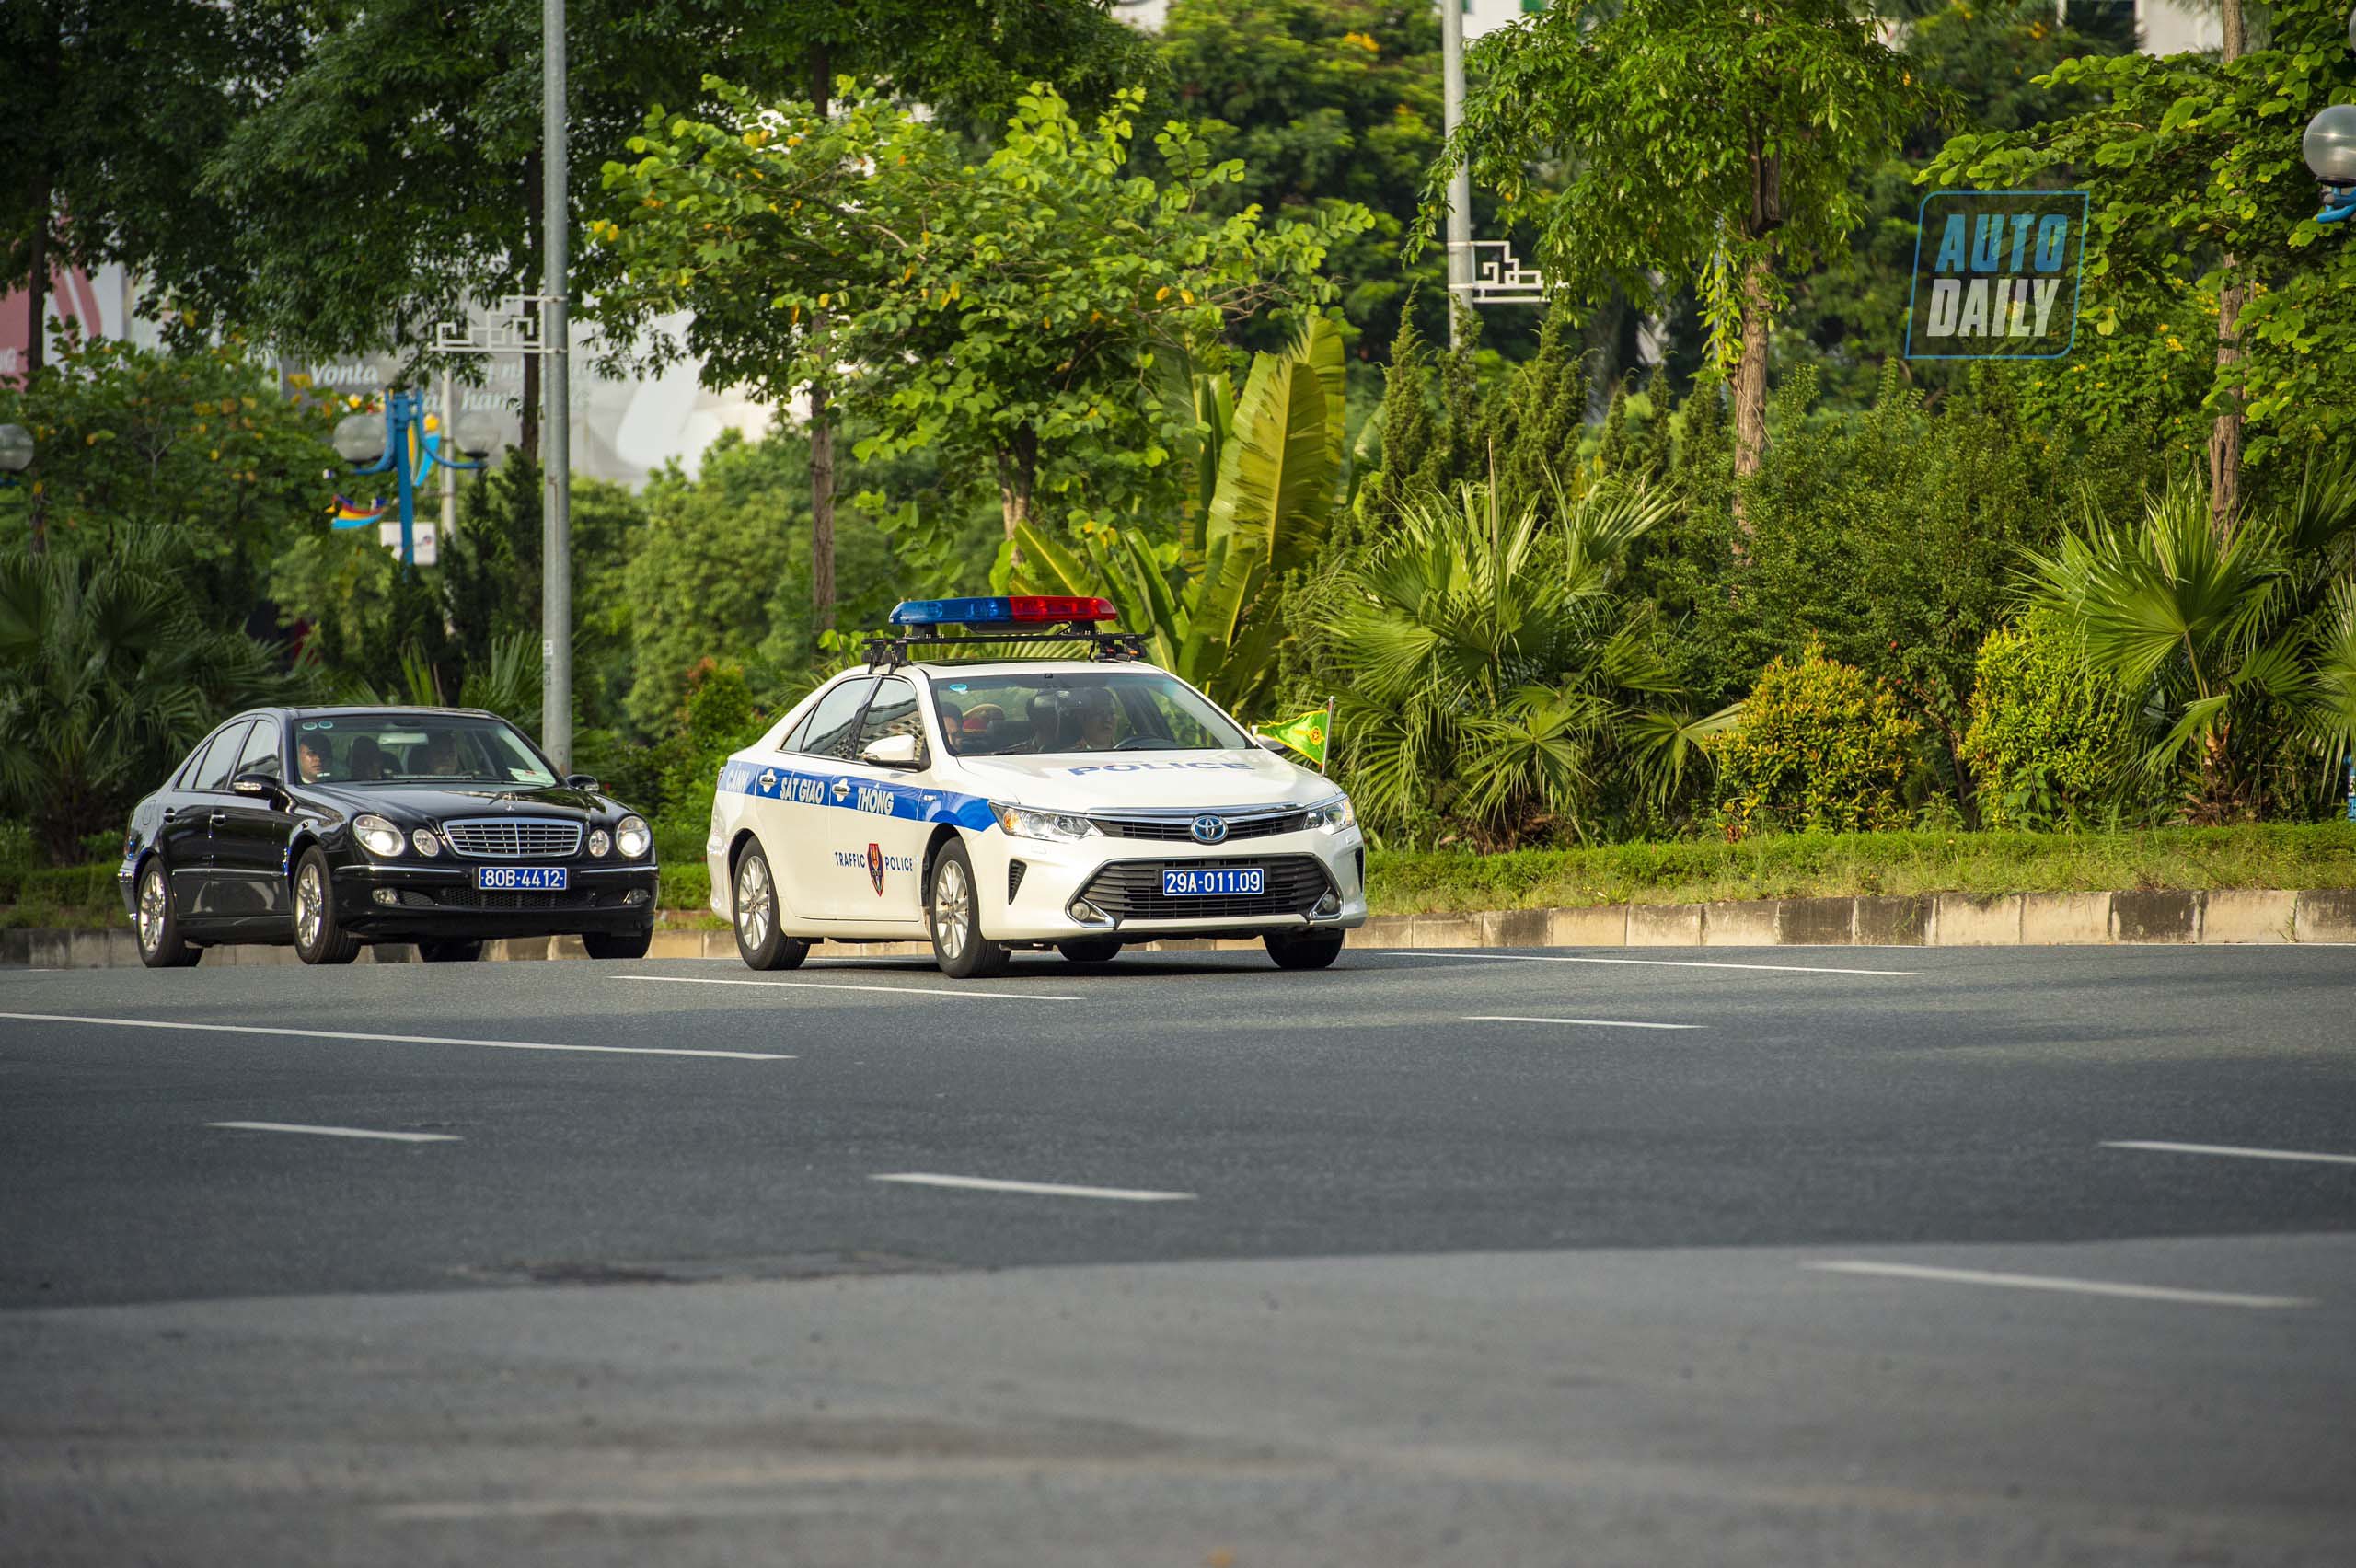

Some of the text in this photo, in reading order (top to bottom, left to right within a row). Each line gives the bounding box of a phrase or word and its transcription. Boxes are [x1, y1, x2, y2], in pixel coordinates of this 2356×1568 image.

[1068, 762, 1255, 776] POLICE
[799, 779, 825, 804] GIAO
[835, 851, 913, 872] TRAFFIC POLICE
[485, 870, 560, 887] 80B-4412
[1166, 871, 1261, 893] 29A-011.09
